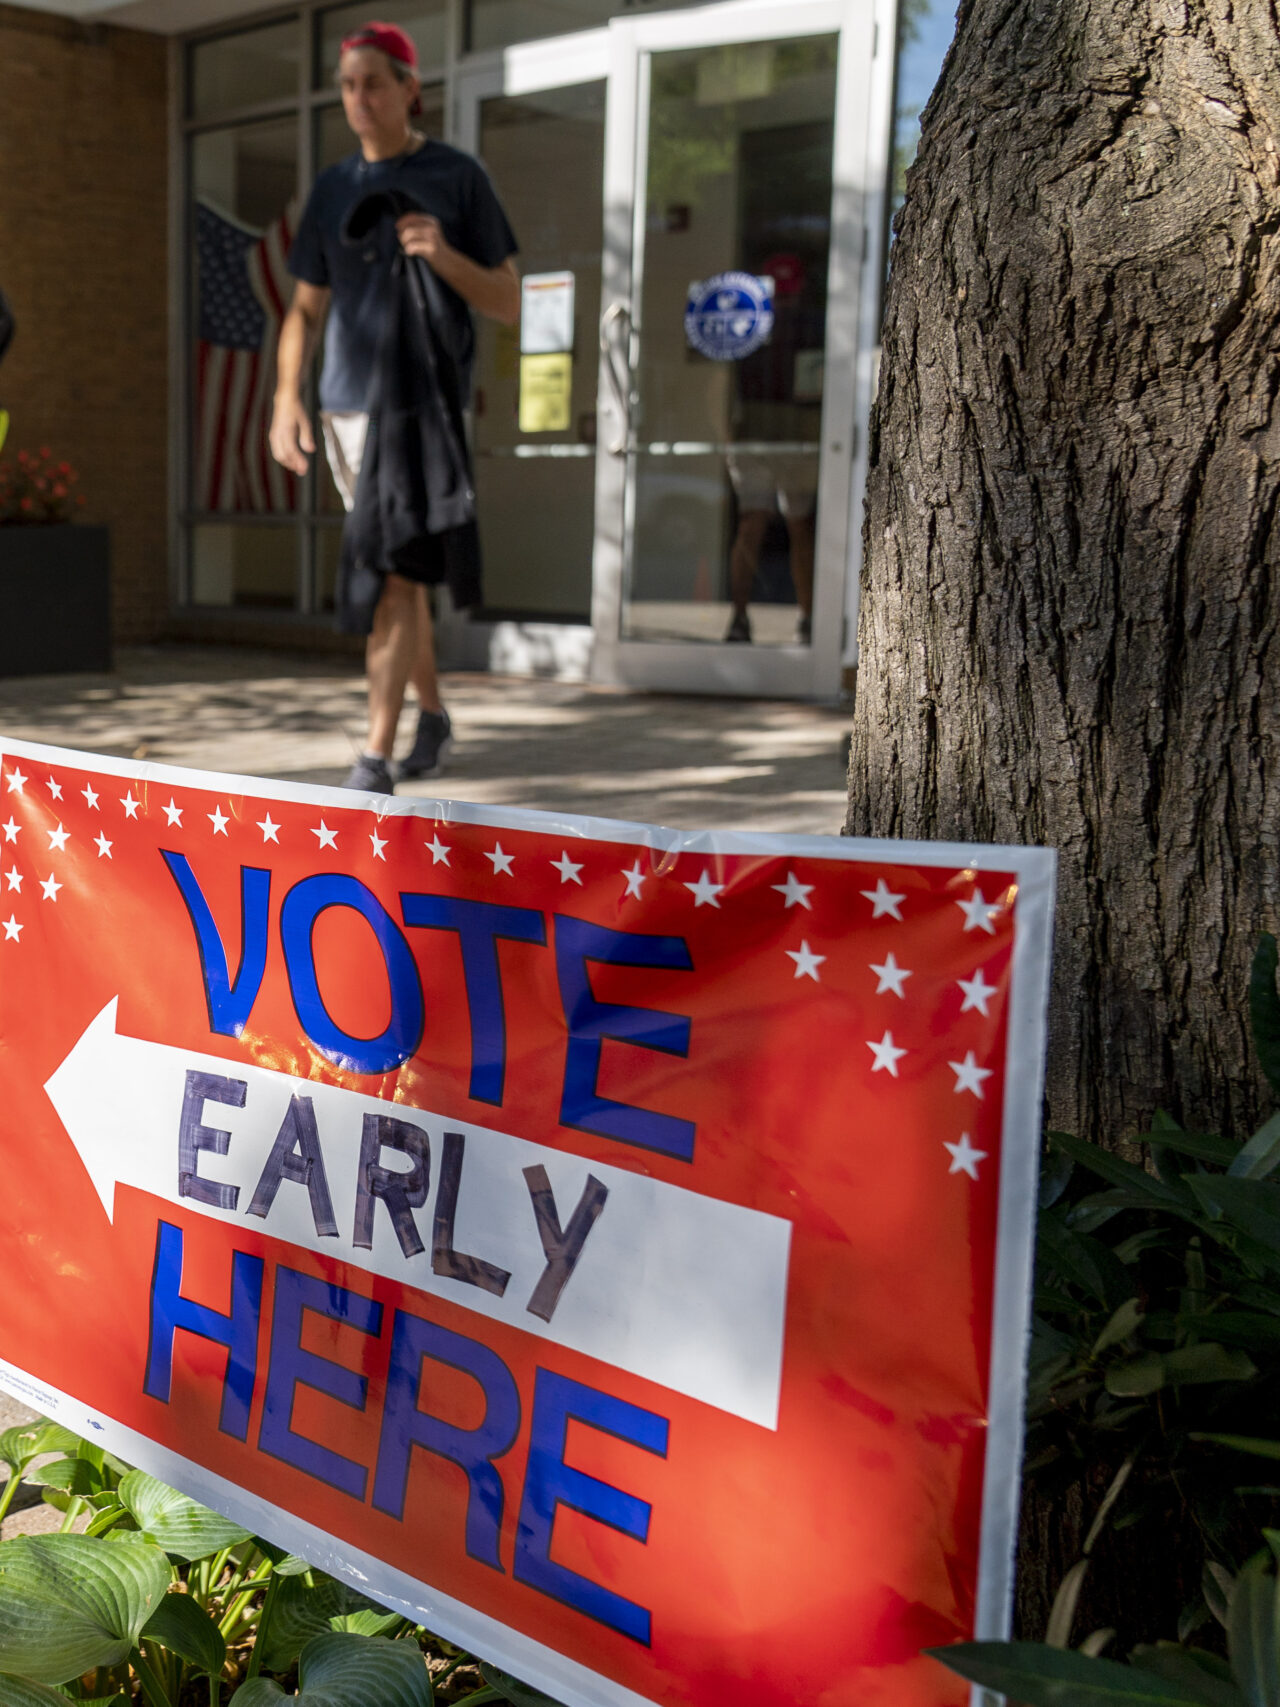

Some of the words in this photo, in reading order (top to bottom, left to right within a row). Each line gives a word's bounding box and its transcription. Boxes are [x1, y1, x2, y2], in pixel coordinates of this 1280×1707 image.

[159, 847, 696, 1165] VOTE
[176, 1068, 610, 1324] EARLY
[142, 1218, 672, 1648] HERE
